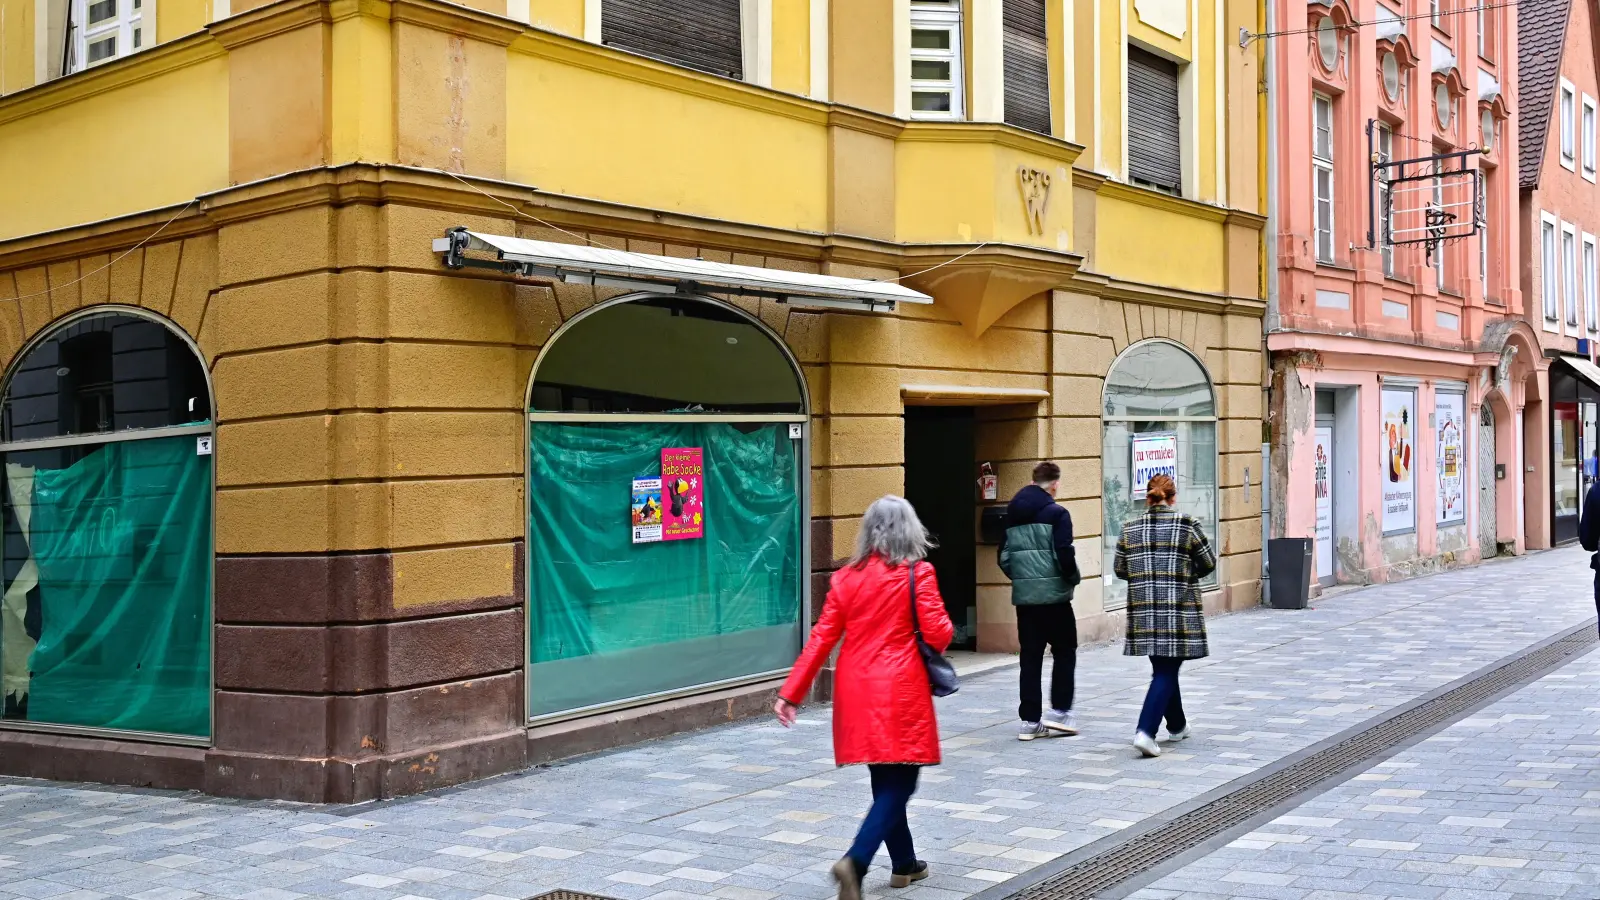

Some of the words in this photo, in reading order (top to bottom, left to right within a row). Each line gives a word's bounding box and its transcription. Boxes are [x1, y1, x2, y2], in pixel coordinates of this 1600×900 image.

[1136, 451, 1144, 461] zu
[1145, 446, 1174, 460] vermieten
[662, 462, 680, 476] Rabe
[680, 463, 702, 476] Socke
